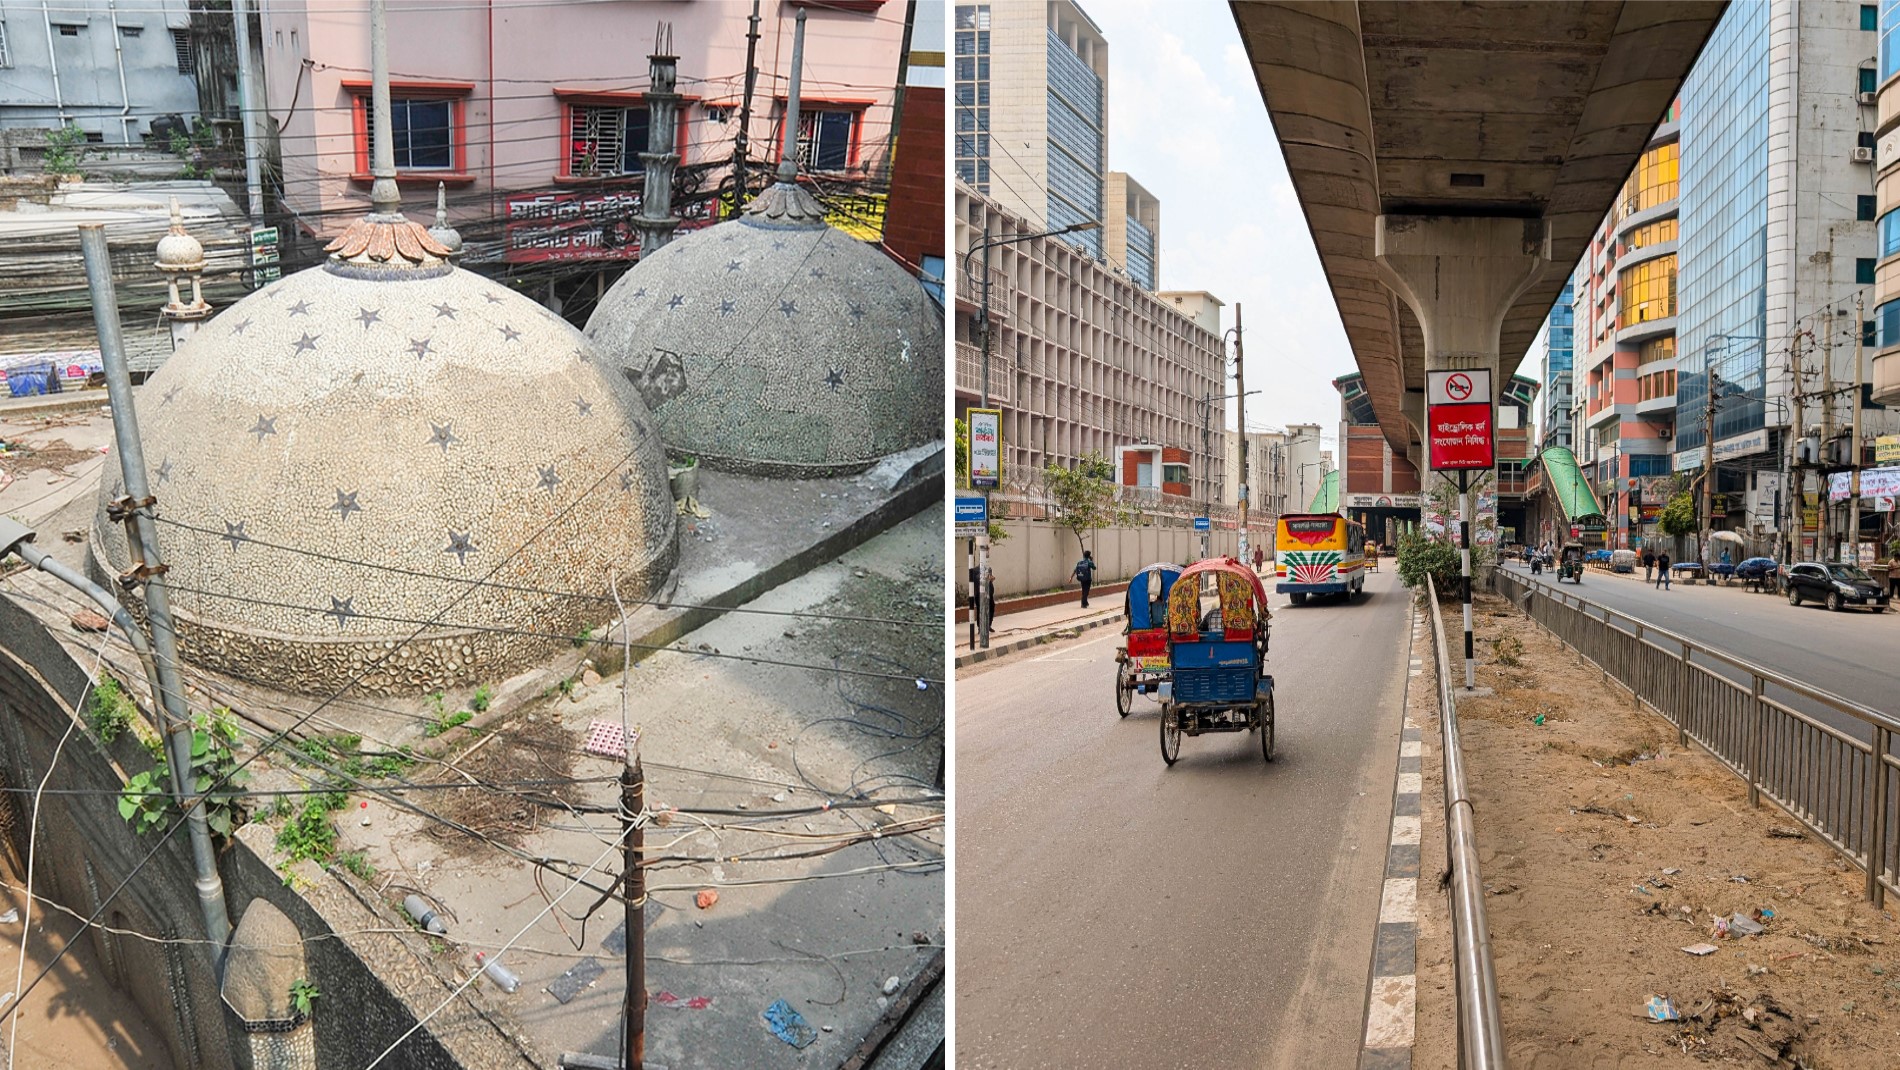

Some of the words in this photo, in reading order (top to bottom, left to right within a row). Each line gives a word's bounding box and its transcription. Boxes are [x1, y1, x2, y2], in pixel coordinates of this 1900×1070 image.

[1437, 420, 1474, 433] হাইড্রোলিক
[1475, 420, 1486, 432] হর্ন
[1434, 436, 1464, 447] সংযোজন
[1465, 434, 1485, 446] নিষিদ্ধ
